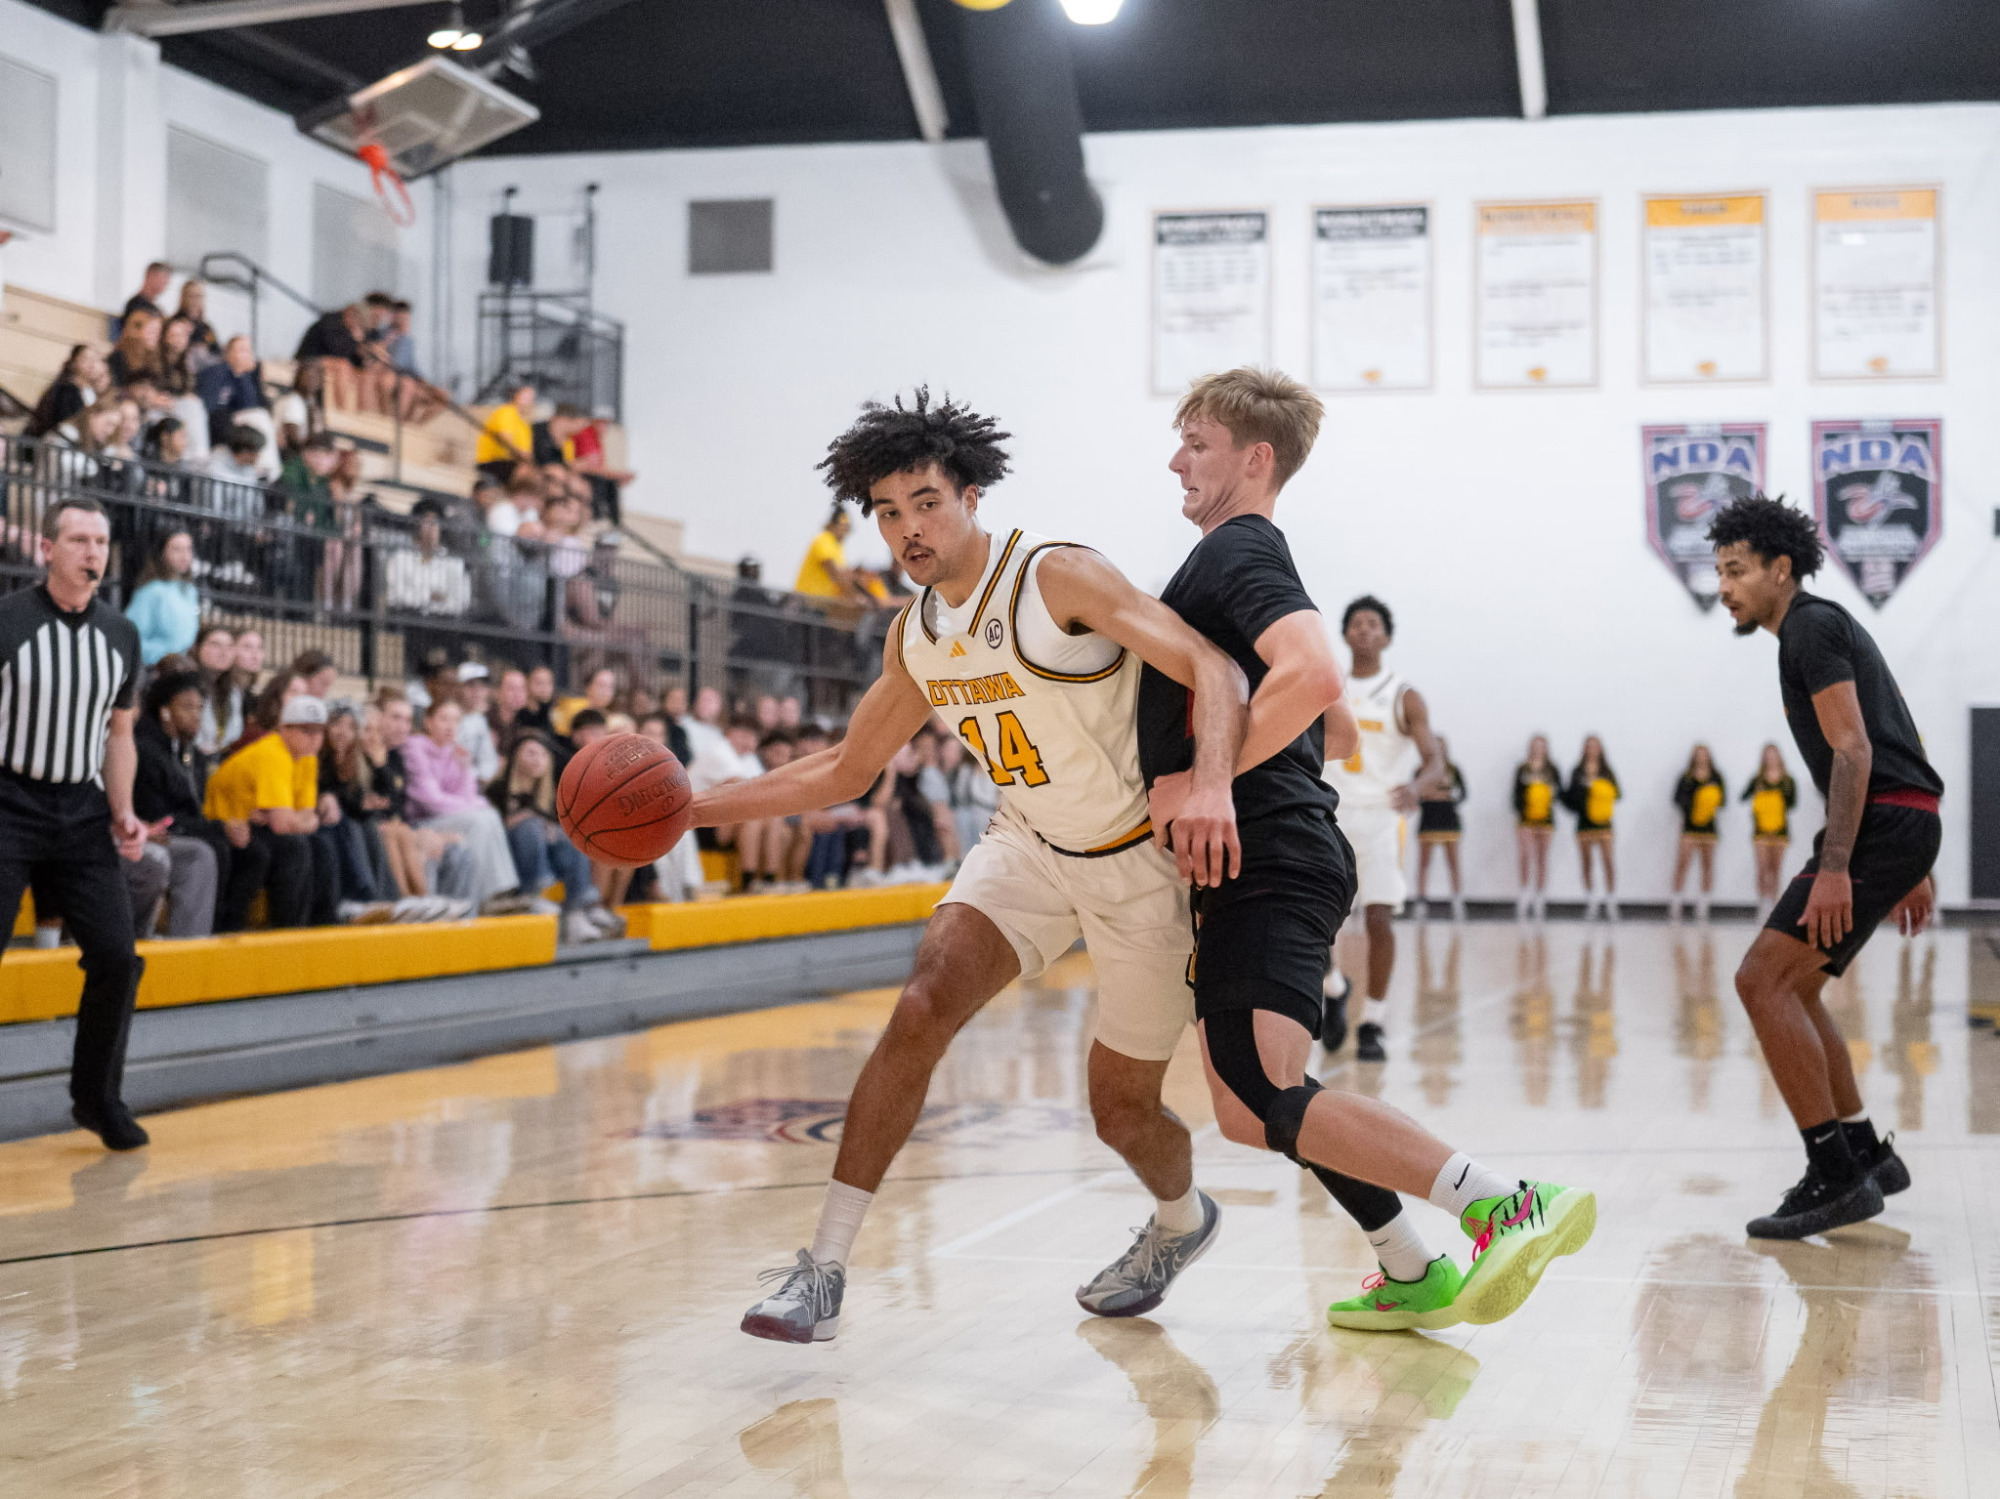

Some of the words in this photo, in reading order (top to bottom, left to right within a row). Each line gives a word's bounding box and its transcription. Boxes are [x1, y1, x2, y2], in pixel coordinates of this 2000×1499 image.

[1652, 440, 1753, 475] NDA
[1819, 437, 1929, 473] NDA
[987, 623, 1001, 644] AC
[926, 671, 1026, 707] OTTAWA
[958, 710, 1051, 788] 14
